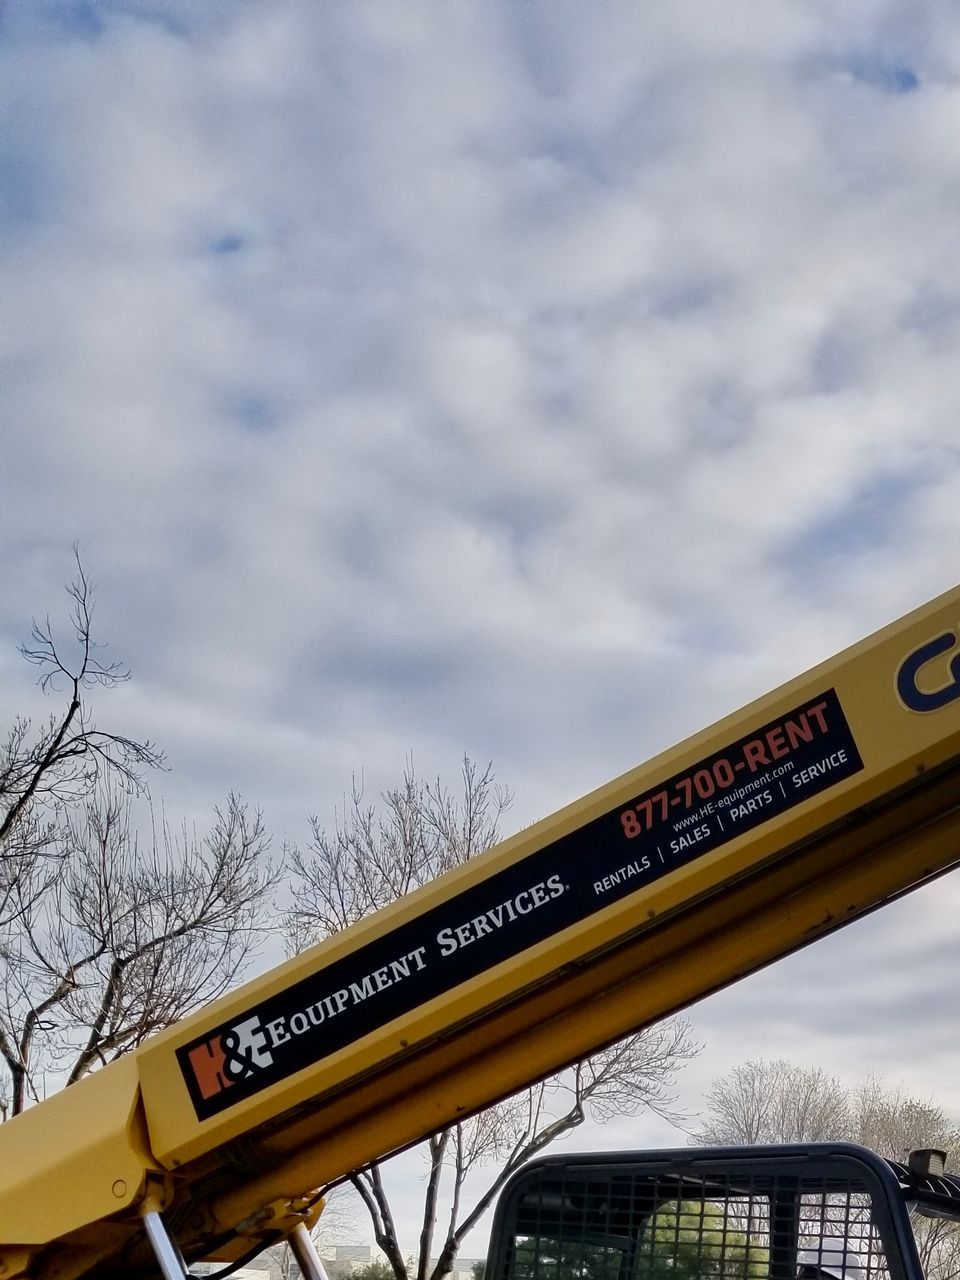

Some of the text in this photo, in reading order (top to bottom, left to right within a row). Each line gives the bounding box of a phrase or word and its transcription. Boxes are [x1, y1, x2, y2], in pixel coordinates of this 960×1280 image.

[593, 749, 848, 895] RENTALS SALES PARTS SERVICE
[619, 701, 830, 840] 877-700-RENT
[672, 759, 795, 833] www.HE-equipment.com
[188, 874, 565, 1100] H&E EQUIPMENT SERVICES
